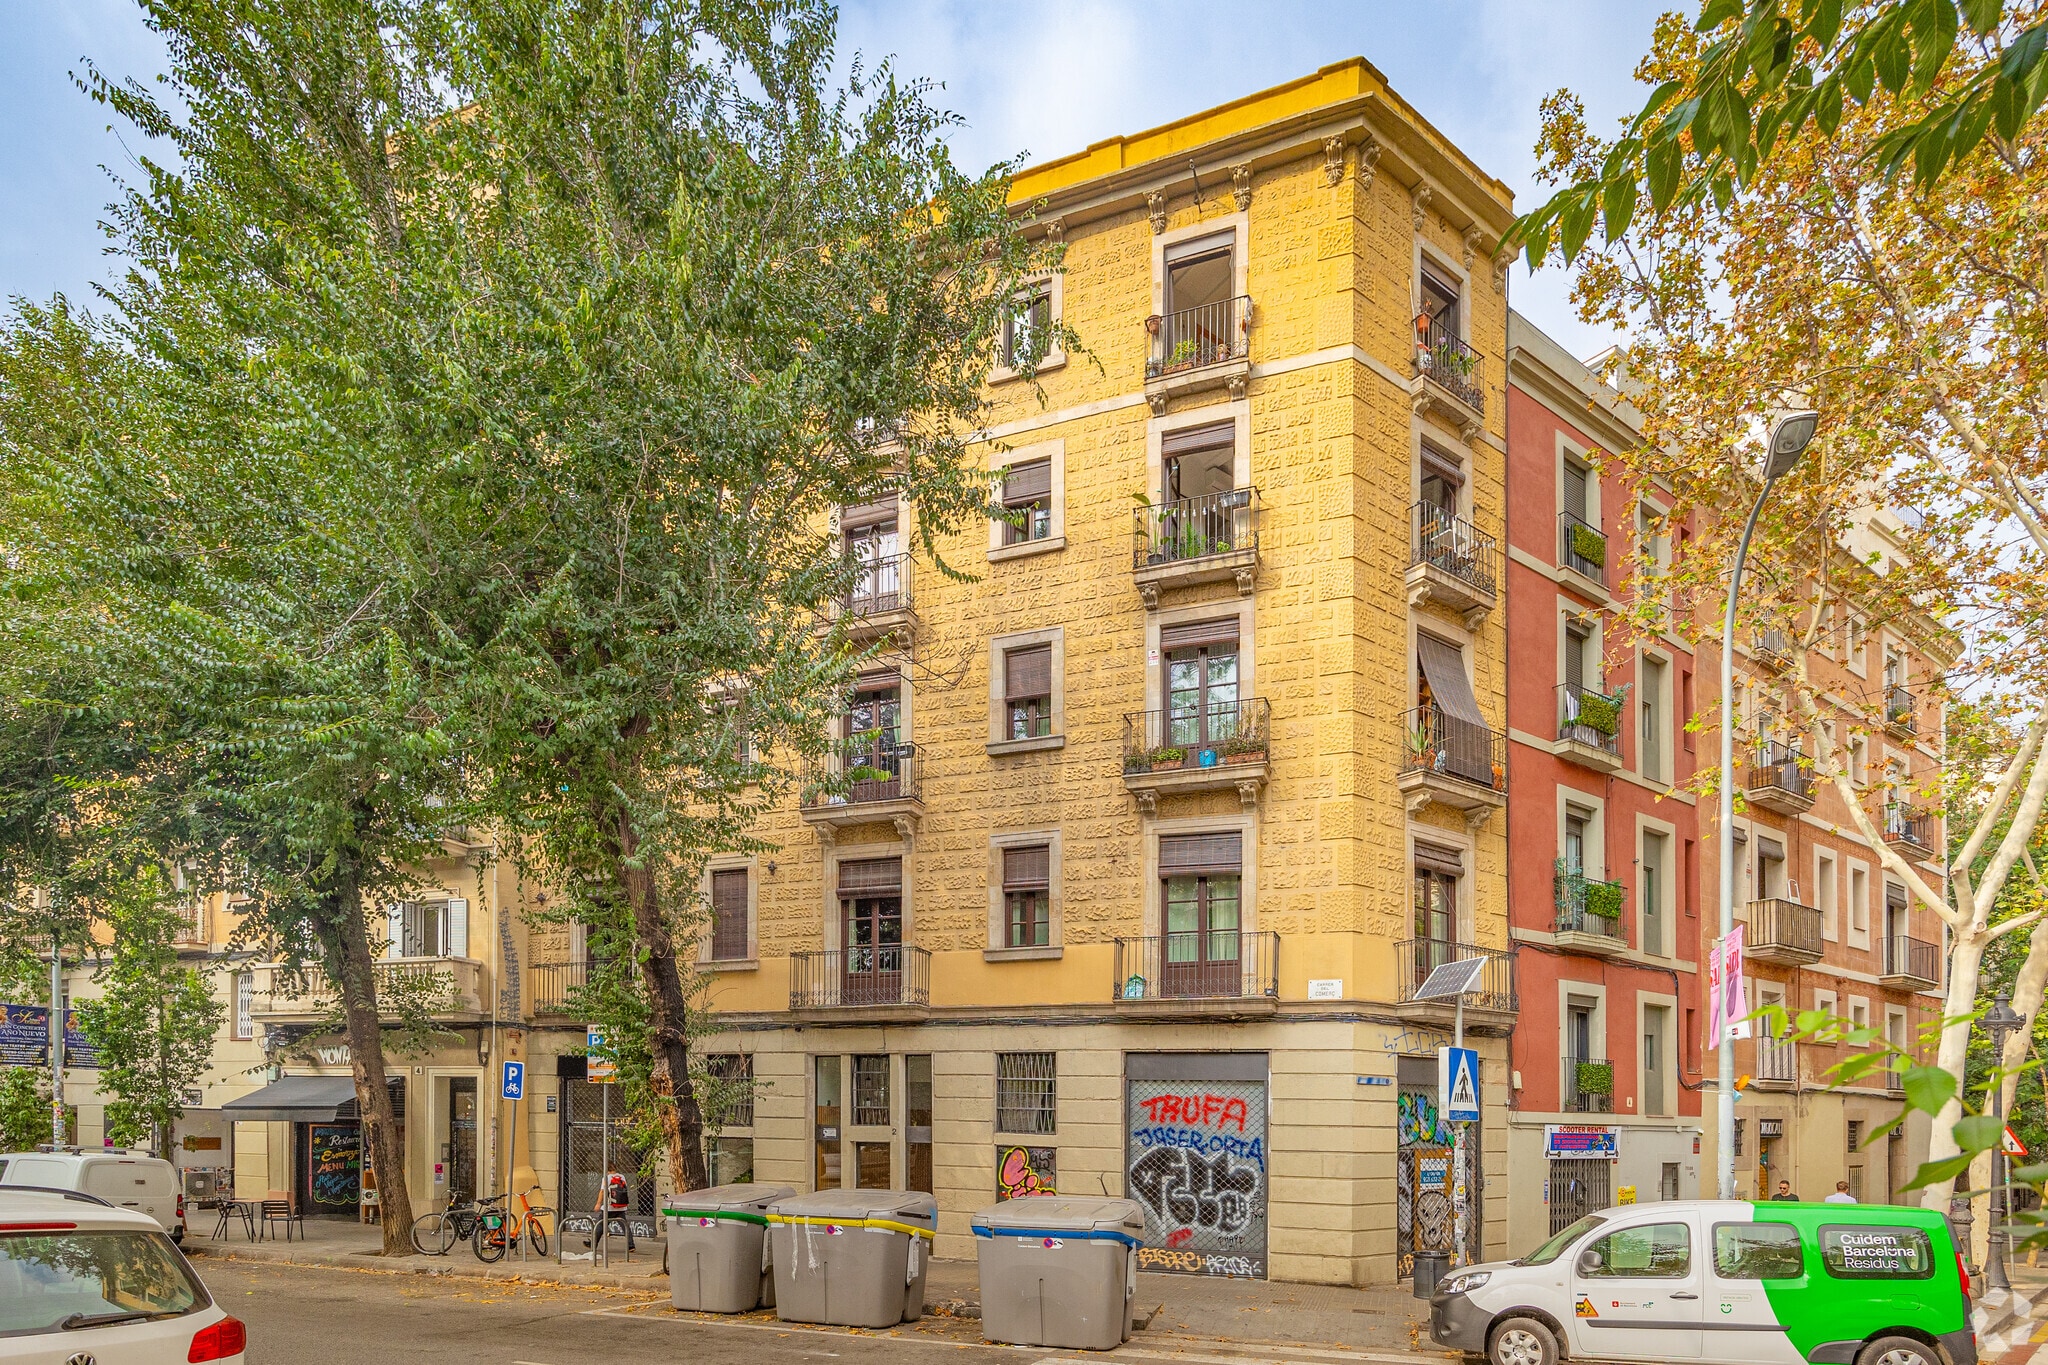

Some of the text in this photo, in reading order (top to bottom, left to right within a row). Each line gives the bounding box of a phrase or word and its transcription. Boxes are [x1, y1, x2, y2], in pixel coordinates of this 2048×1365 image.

[509, 1067, 518, 1080] P
[1140, 1094, 1247, 1132] TRUFA
[1840, 1234, 1897, 1245] Cuidem
[1843, 1246, 1916, 1257] Barcelona
[1844, 1257, 1899, 1269] Residus
